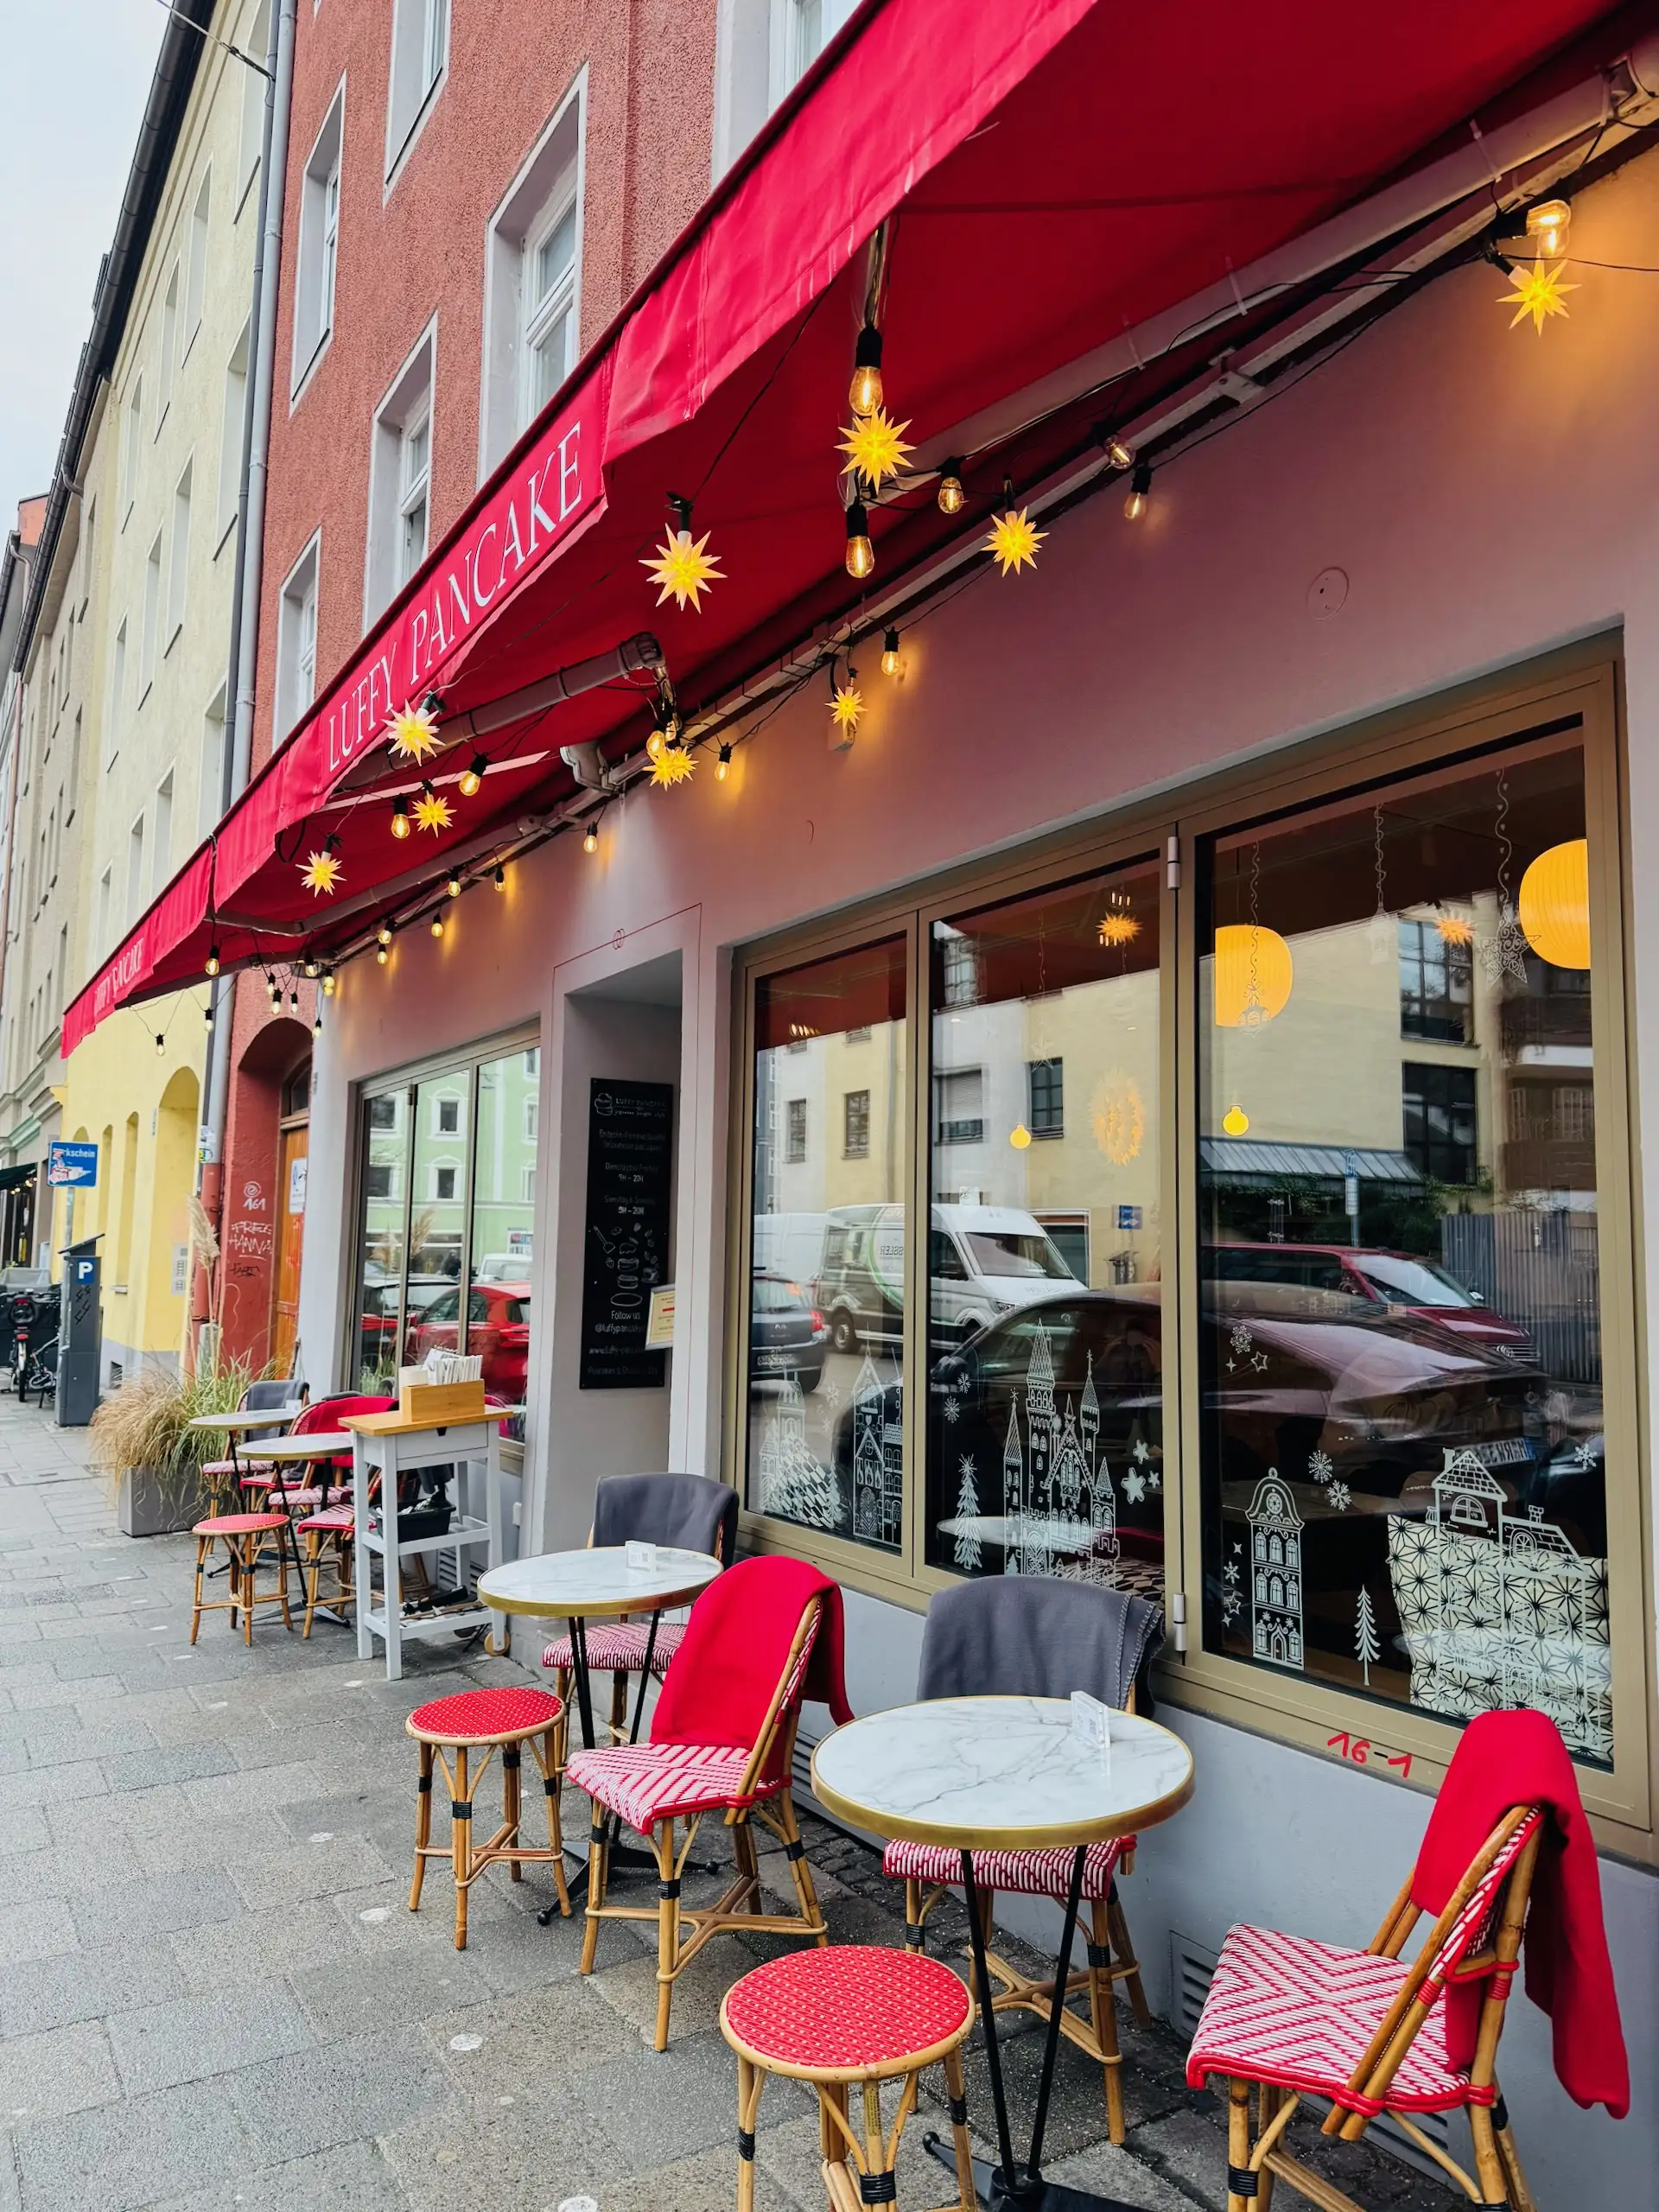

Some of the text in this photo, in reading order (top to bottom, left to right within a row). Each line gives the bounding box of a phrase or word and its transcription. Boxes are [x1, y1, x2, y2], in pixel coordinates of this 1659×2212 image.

[328, 420, 583, 772] LUFFY PANCAKE
[66, 1147, 95, 1158] kschein
[243, 1198, 266, 1211] 161
[79, 1262, 93, 1280] P
[611, 1310, 632, 1319] Follow
